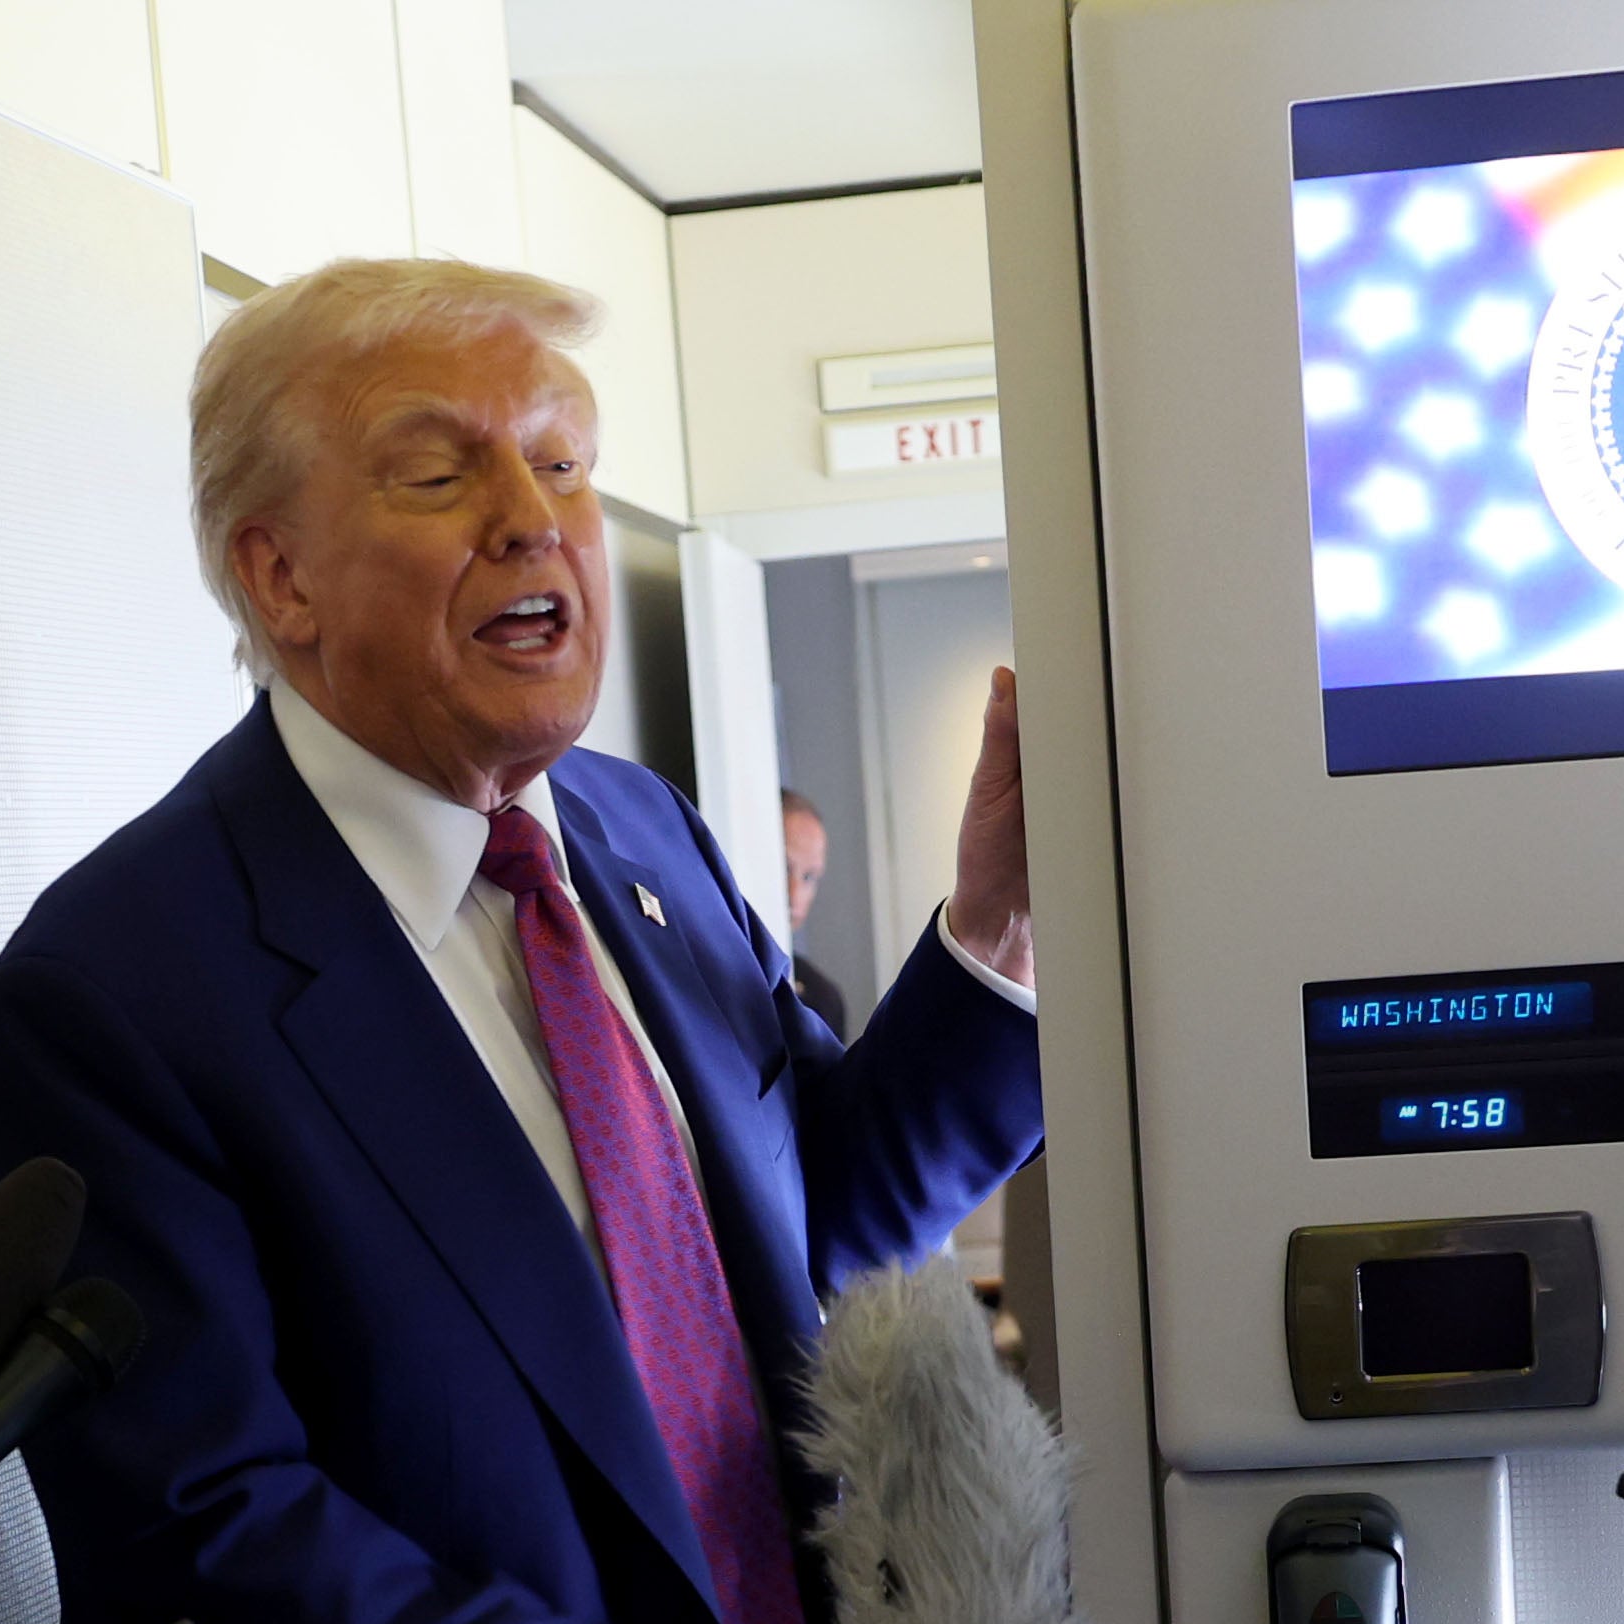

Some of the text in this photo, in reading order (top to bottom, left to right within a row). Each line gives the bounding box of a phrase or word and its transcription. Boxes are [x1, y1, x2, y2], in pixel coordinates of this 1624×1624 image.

[896, 418, 983, 462] EXIT
[1340, 991, 1554, 1028] WASHINGTON
[1398, 1097, 1506, 1129] AM 7:58
